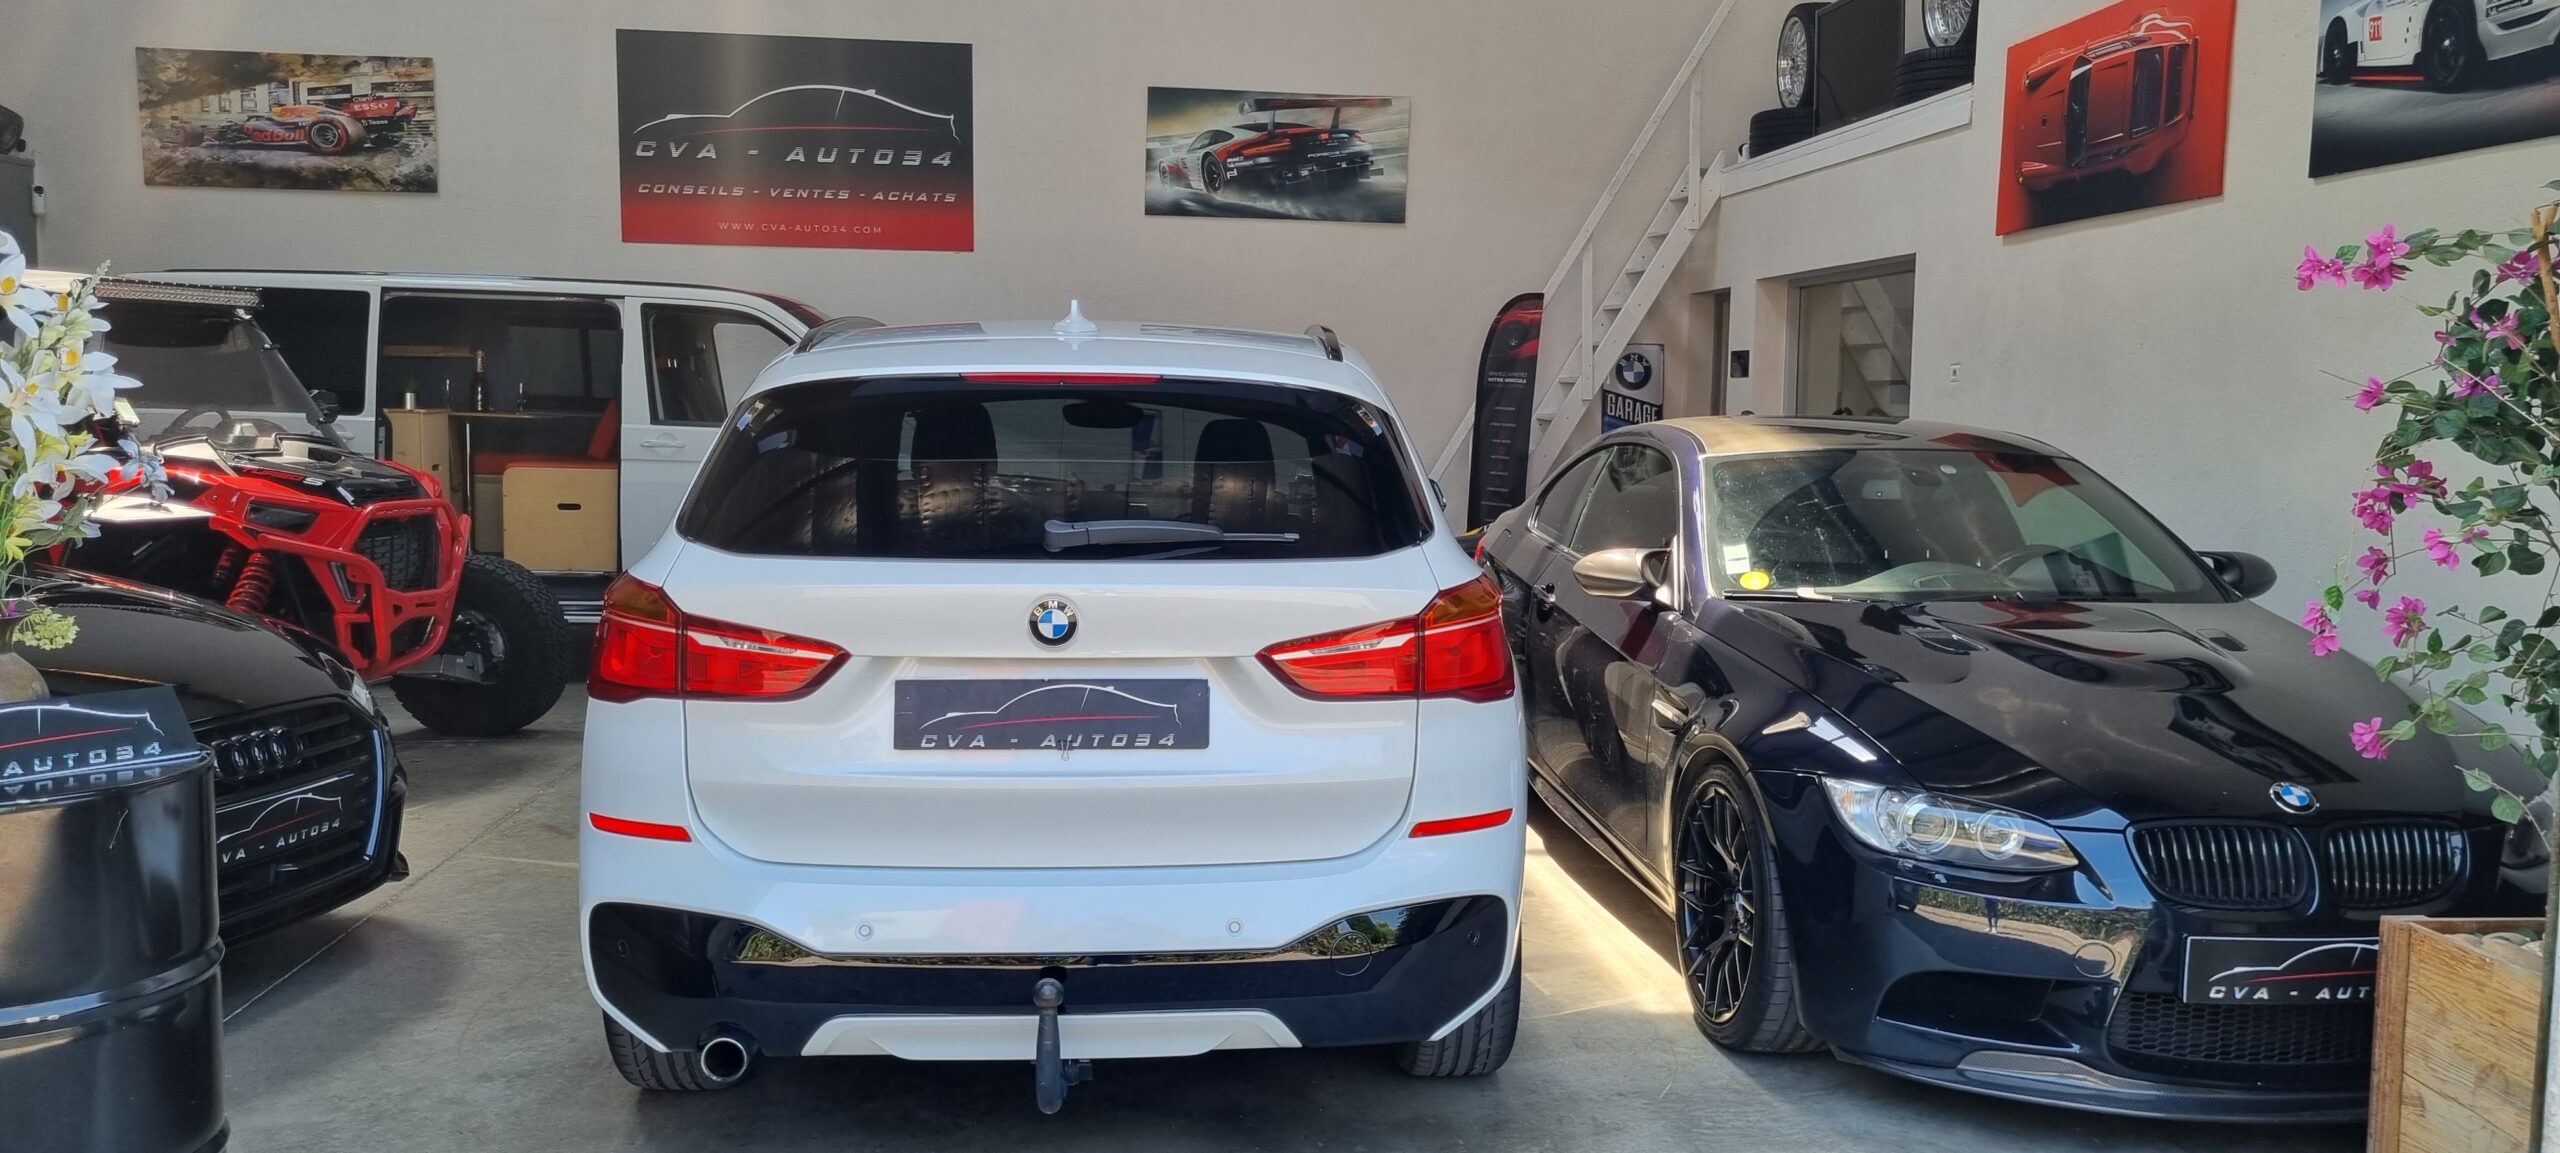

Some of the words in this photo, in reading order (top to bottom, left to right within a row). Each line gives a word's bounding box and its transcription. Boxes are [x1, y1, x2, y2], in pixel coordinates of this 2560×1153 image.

[354, 103, 388, 111] ESSO
[635, 140, 718, 159] CVA
[785, 147, 952, 167] AUTO34
[638, 183, 744, 197] CONSEILS
[769, 187, 850, 200] VENTES
[873, 190, 957, 203] ACHATS
[718, 221, 882, 235] WWW.CVA-AUTO34.COM
[1619, 354, 1649, 367] BMW
[1607, 393, 1659, 424] GARAGE
[1033, 600, 1073, 616] BMW
[920, 734, 985, 748] CVA
[1041, 733, 1175, 748] AUTO34
[3, 741, 162, 777] AUTO34
[276, 819, 340, 848] AUTO34
[2209, 986, 2269, 999] CVA
[2315, 986, 2377, 999] AUT
